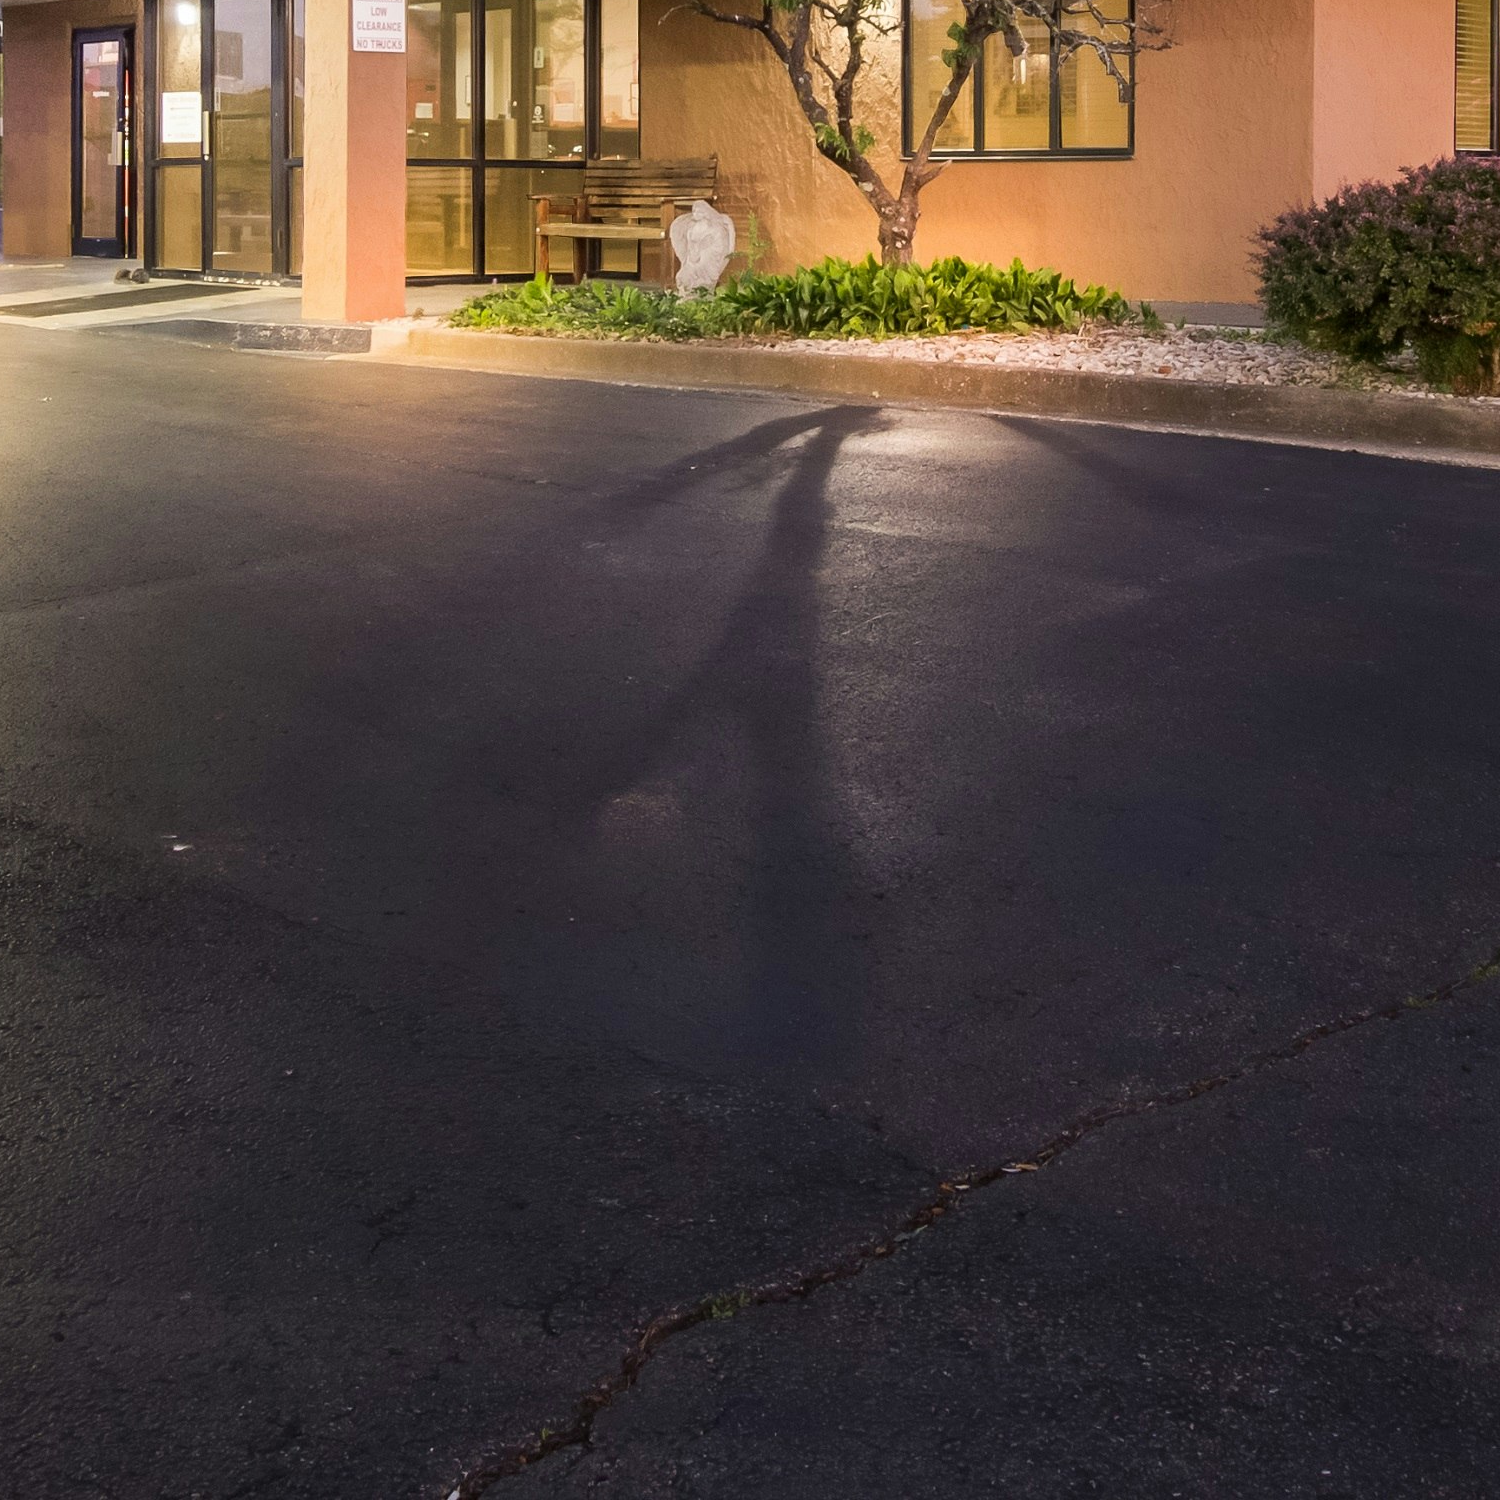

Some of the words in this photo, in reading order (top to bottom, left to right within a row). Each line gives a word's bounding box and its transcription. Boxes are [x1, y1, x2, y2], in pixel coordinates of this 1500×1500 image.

[370, 7, 388, 17] LOW
[356, 21, 402, 32] CLEARANCE
[356, 40, 369, 49] NO
[371, 40, 403, 50] TRUCKS
